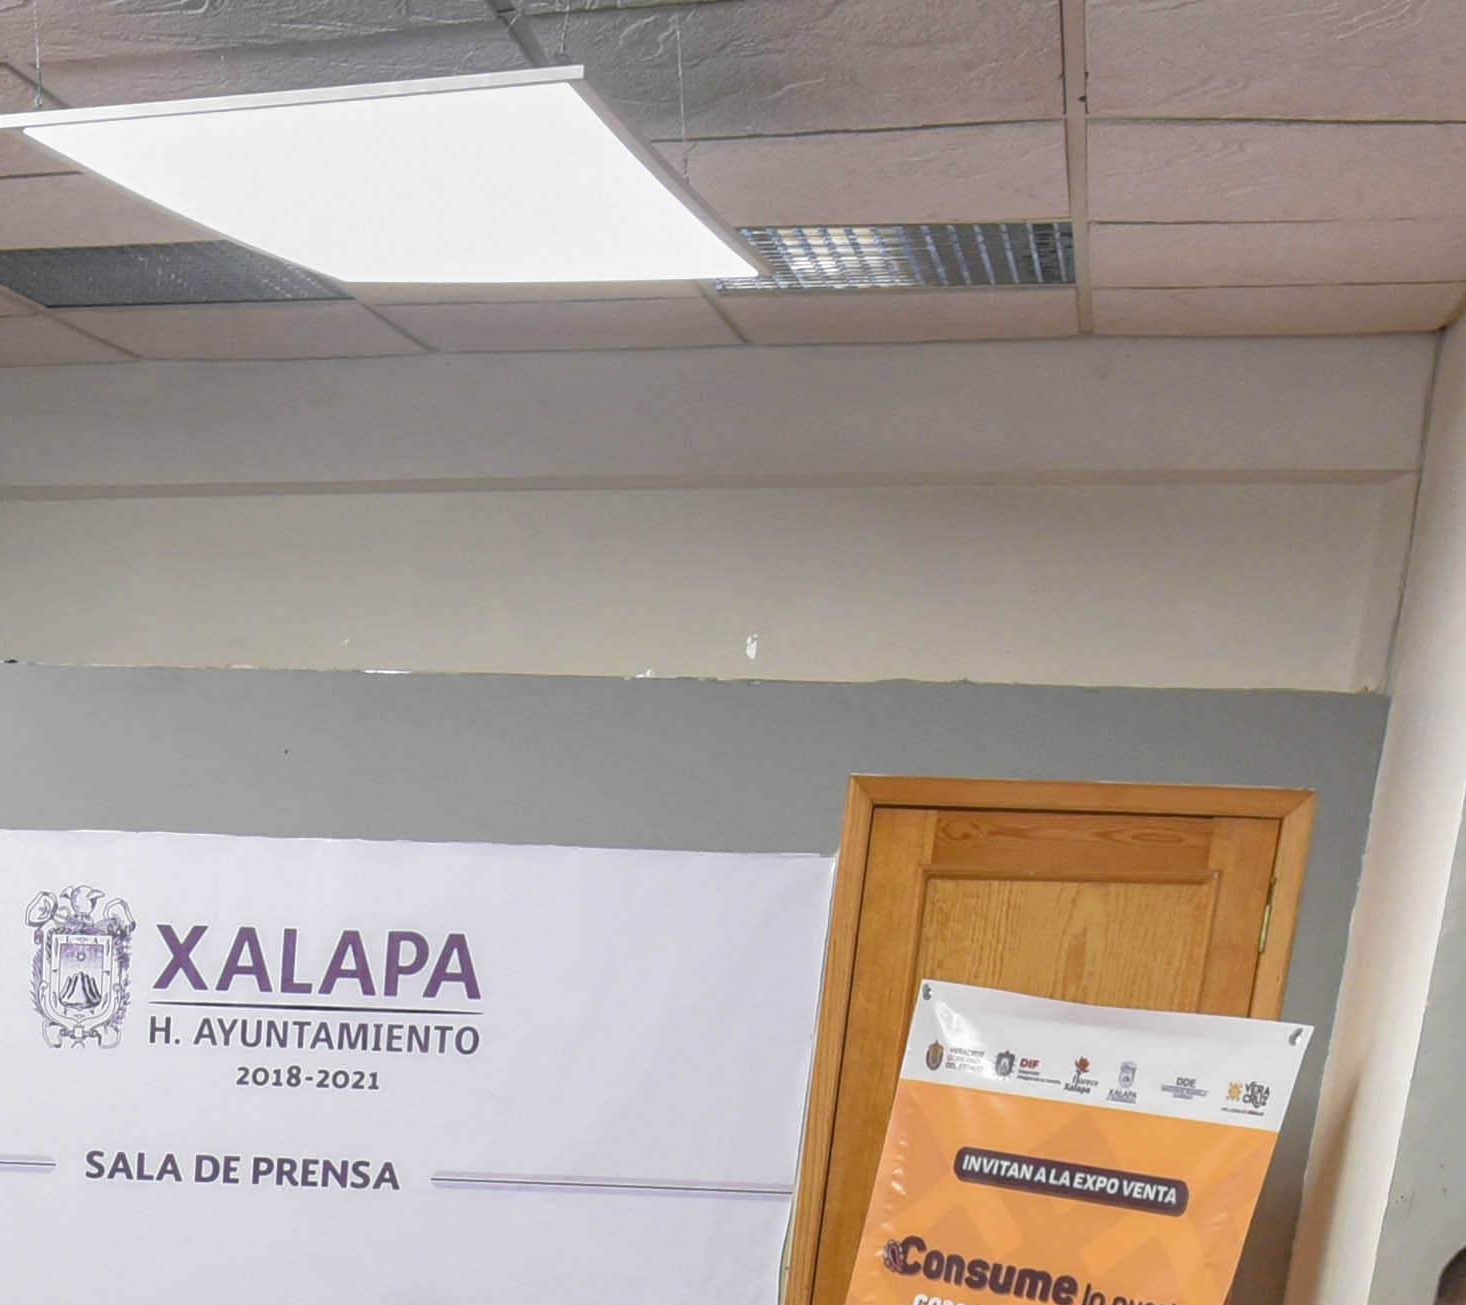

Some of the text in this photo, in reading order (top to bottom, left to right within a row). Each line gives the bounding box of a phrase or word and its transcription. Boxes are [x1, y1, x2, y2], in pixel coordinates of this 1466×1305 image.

[152, 923, 482, 1000] XALAPA
[148, 1016, 481, 1055] H. AYUNTAMIENTO
[235, 1064, 380, 1091] 2018-2021
[1019, 1058, 1040, 1070] DIF
[85, 1150, 400, 1191] SALA DE PRENSA
[962, 1154, 1177, 1204] INVITAN A LA EXPO VENTA
